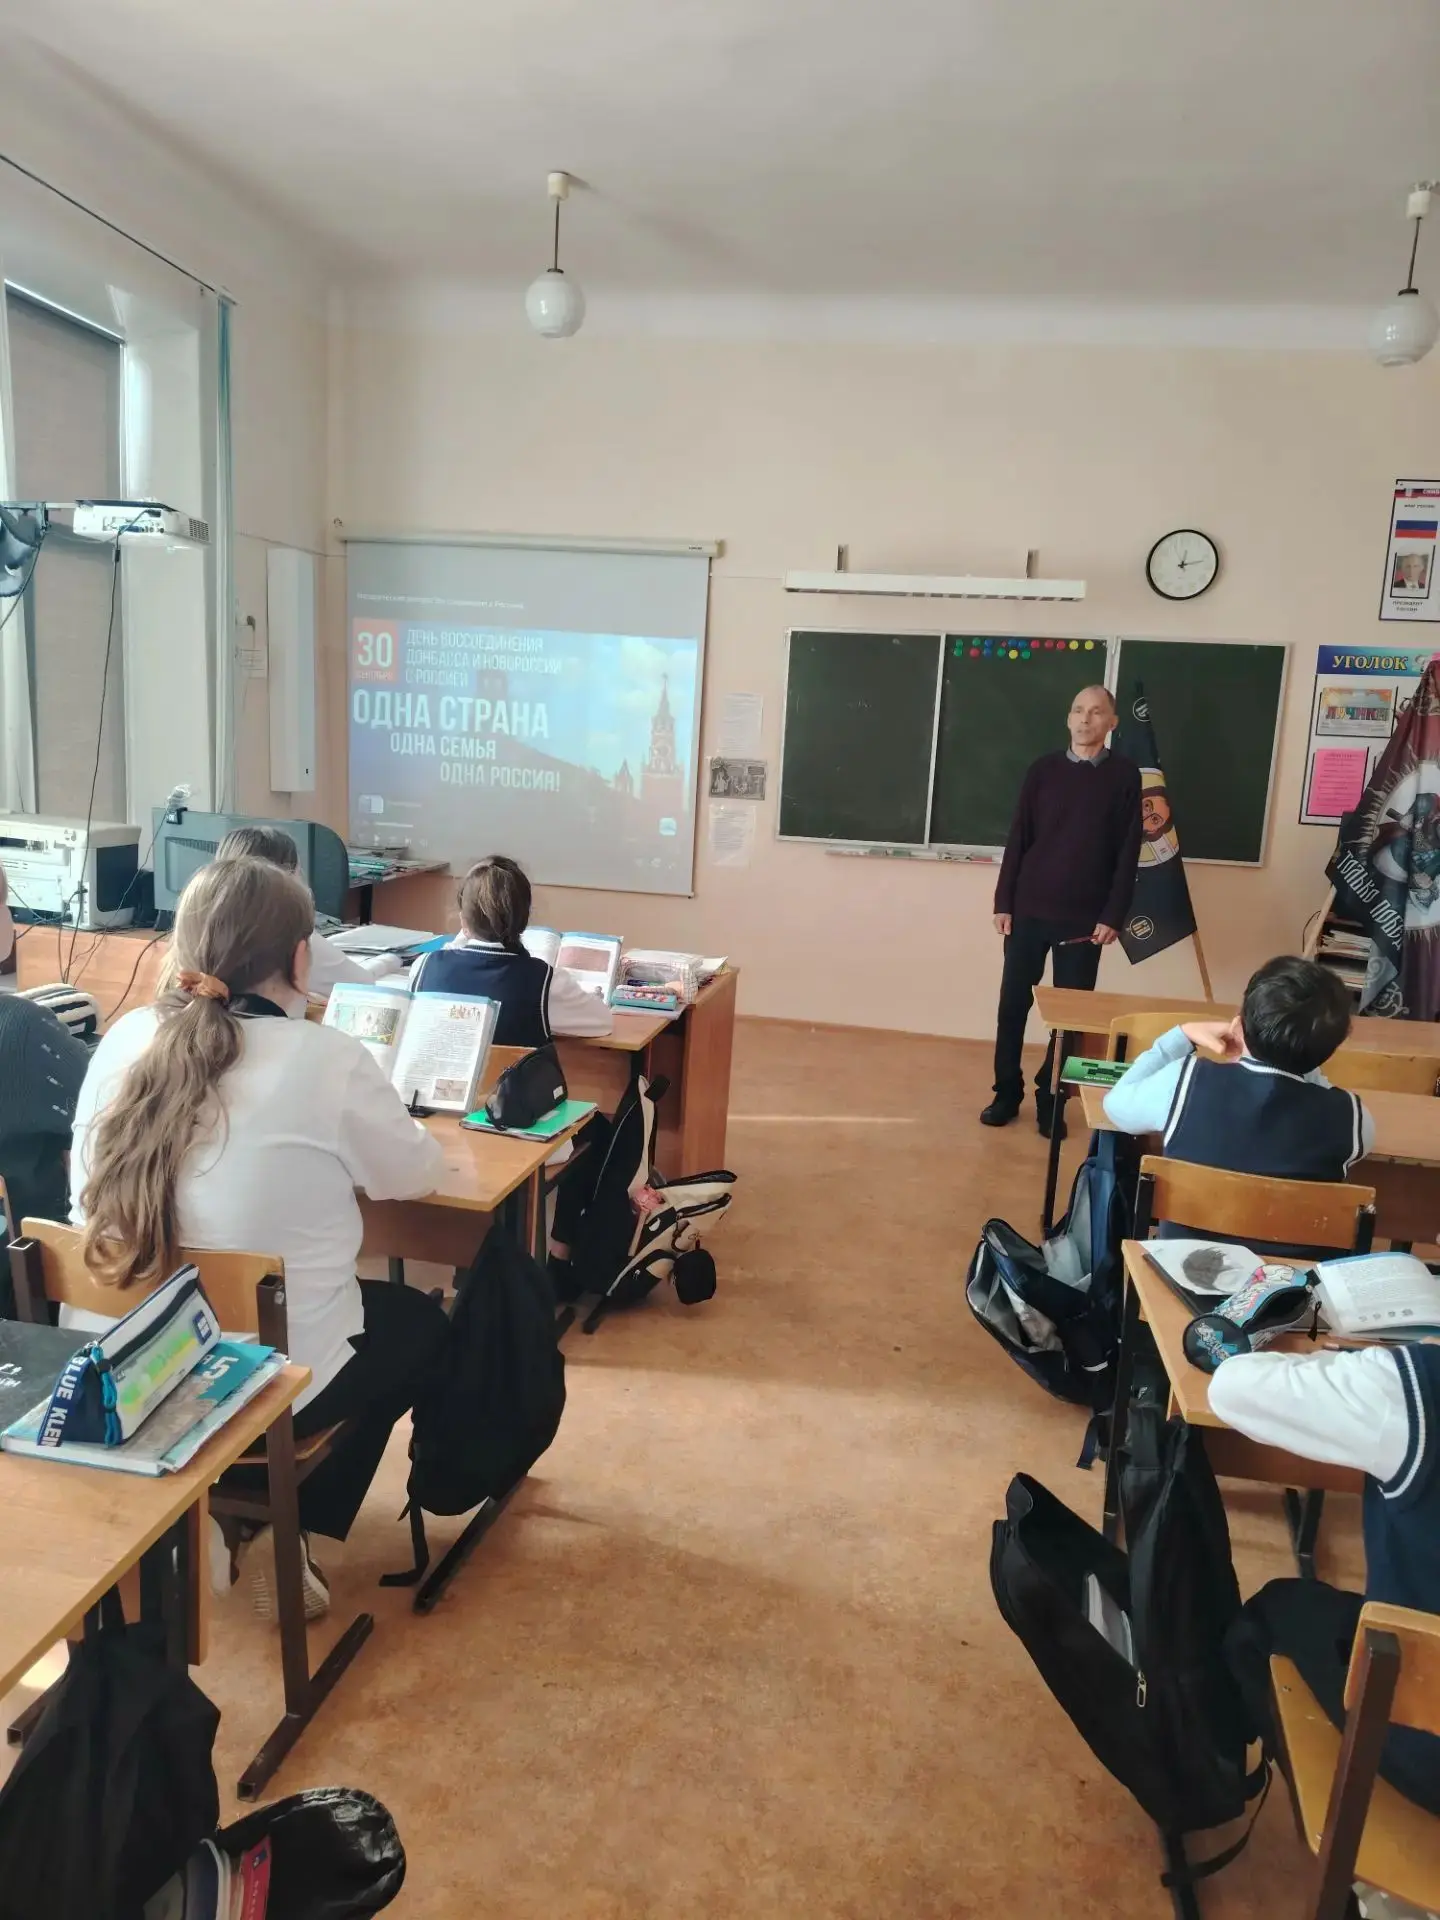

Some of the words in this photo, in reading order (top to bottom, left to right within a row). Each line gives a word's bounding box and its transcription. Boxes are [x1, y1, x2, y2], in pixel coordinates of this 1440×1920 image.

[357, 632, 393, 667] 30
[407, 629, 438, 646] ДЕНЬ
[440, 631, 543, 653] ВОССОЕДИНЕНИЯ
[406, 648, 469, 667] ДОНБАССА
[472, 655, 481, 668] И
[483, 656, 562, 674] НОВОРОССИИ
[1332, 655, 1408, 671] УГОЛОК
[416, 670, 468, 687] РОССИЕЙ
[353, 688, 431, 730] ОДНА
[440, 696, 549, 739] СТРАНА
[390, 732, 436, 756] ОДНА
[440, 736, 497, 760] СЕМЬЯ
[440, 762, 485, 785] ОДНА
[490, 766, 561, 792] РОССИЯ!
[1336, 849, 1380, 903] ТОЛЬКО
[56, 1356, 88, 1400] BLUE
